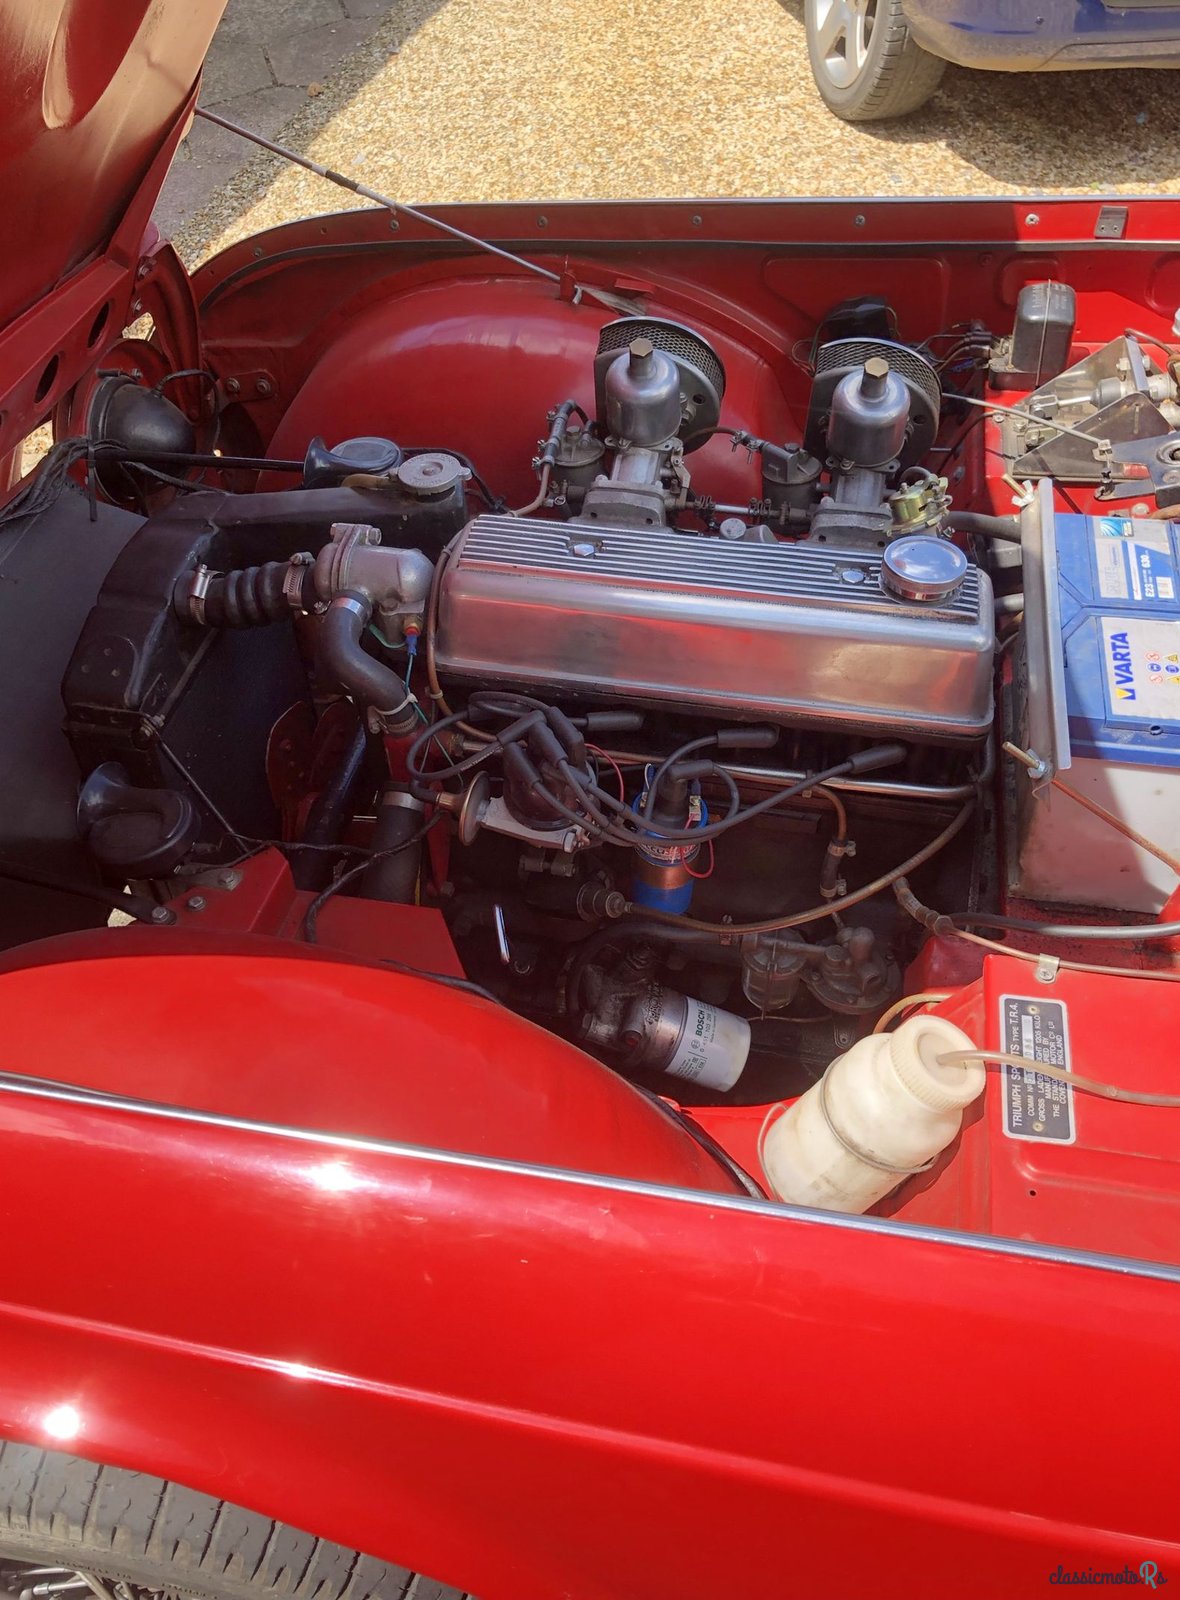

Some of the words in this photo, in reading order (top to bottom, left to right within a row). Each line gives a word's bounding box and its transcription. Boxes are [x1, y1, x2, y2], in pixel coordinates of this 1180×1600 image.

[1110, 632, 1134, 685] VARTA
[695, 1010, 705, 1036] BOSCH
[1012, 1026, 1020, 1041] TYPE
[1042, 1037, 1049, 1045] BY
[1056, 1034, 1064, 1065] ENGLAND
[1010, 1044, 1021, 1081] SPTS
[1011, 1084, 1022, 1127] TRIUMPH
[1027, 1095, 1035, 1117] COMM
[1038, 1098, 1046, 1122] GROSS
